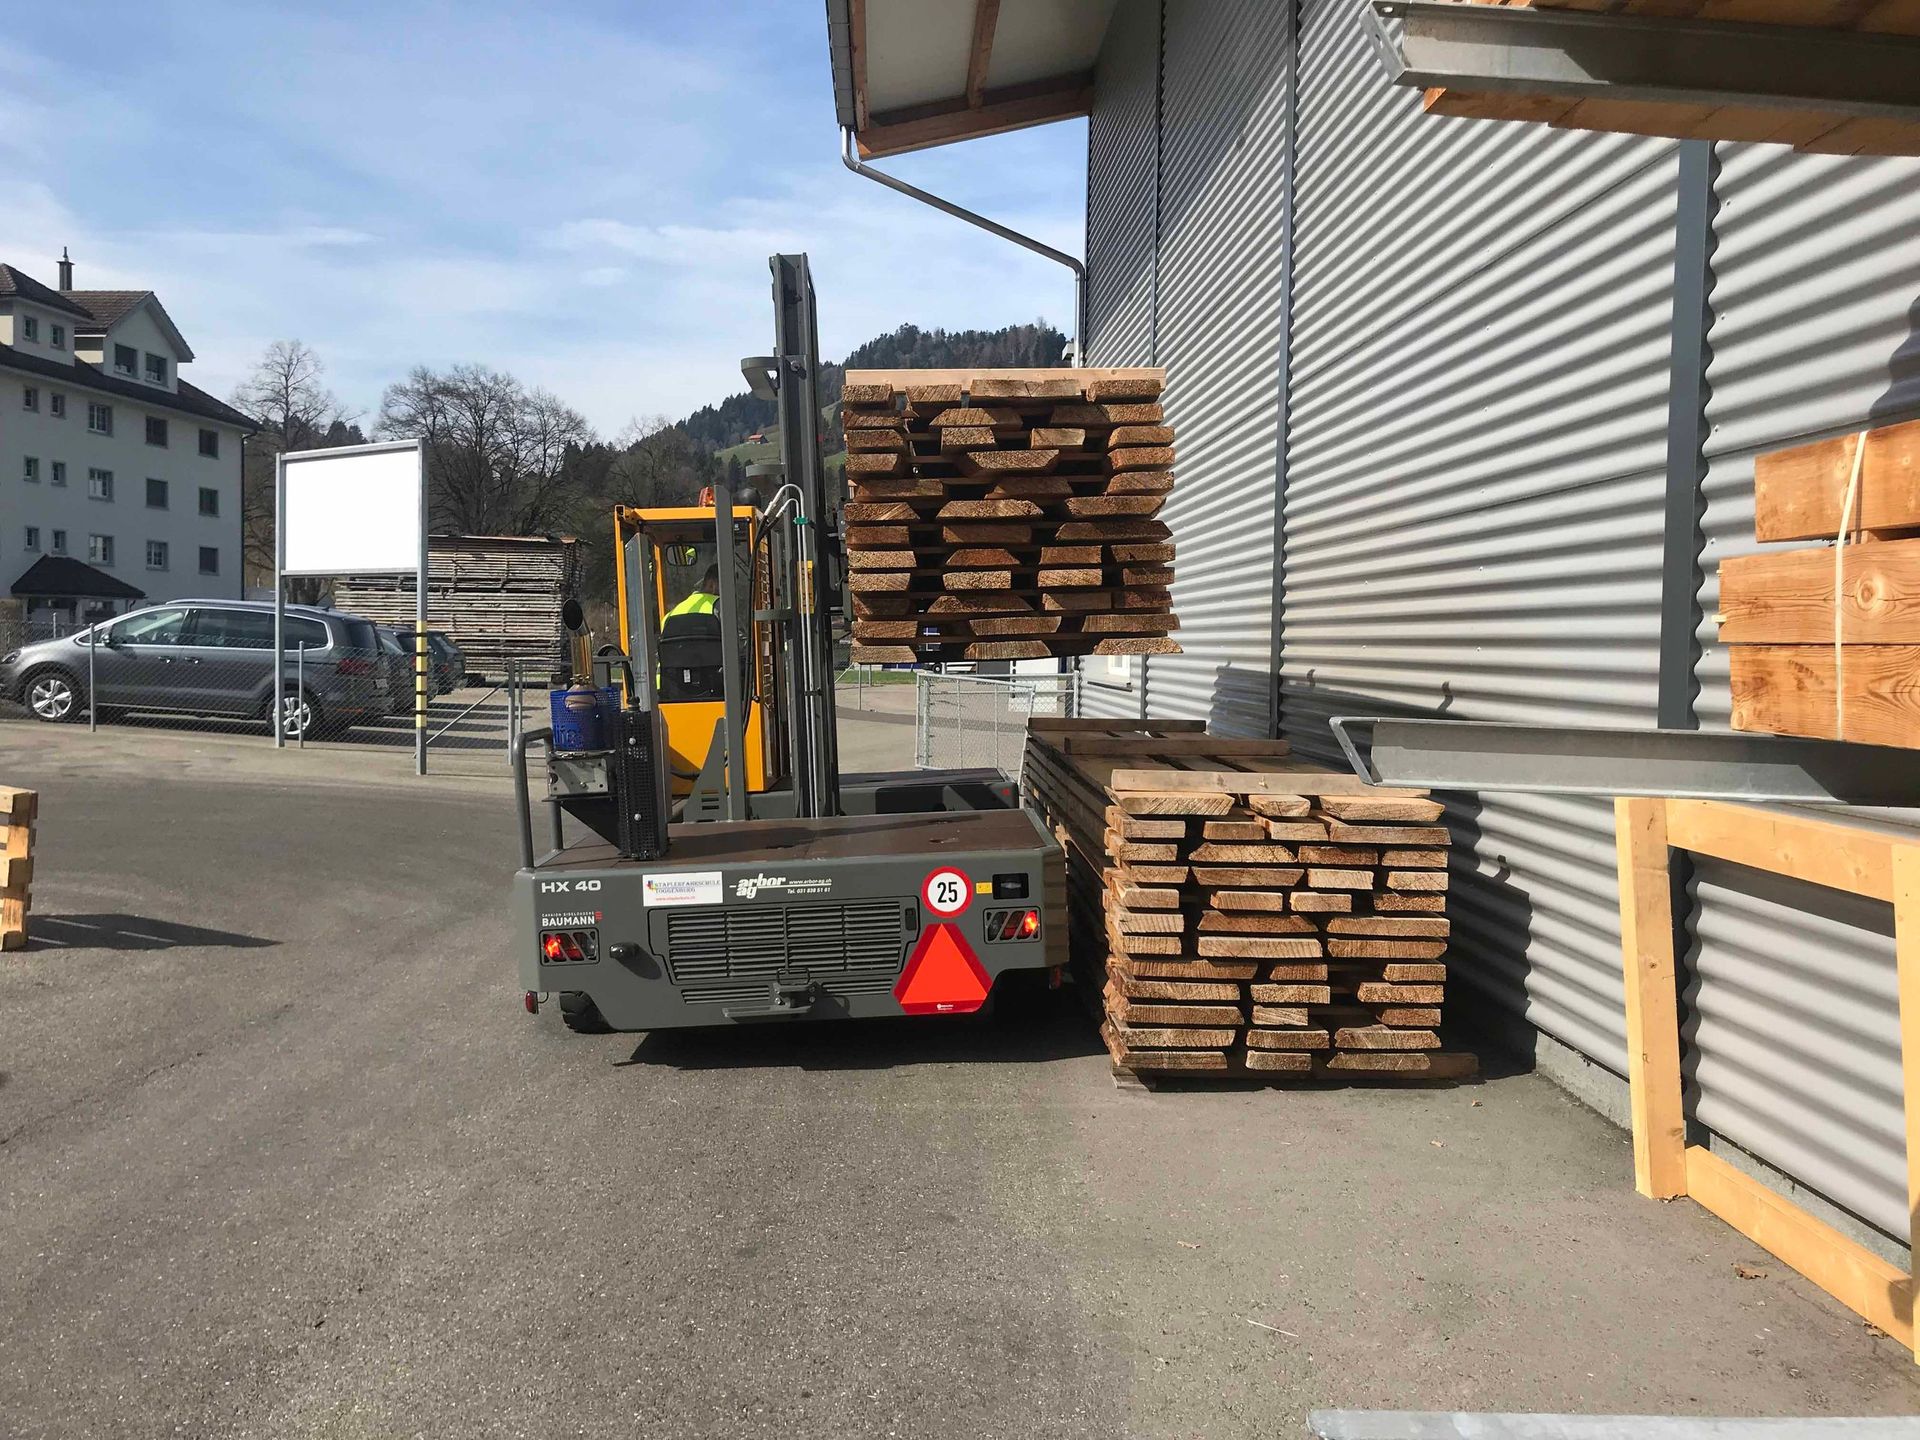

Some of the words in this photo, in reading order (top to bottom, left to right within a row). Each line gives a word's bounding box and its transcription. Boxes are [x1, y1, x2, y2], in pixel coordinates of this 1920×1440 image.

[541, 881, 570, 893] HX
[575, 880, 601, 891] 40
[738, 873, 786, 887] arbor
[736, 886, 758, 899] ag
[937, 881, 958, 903] 25
[542, 916, 595, 926] BAUMANN
